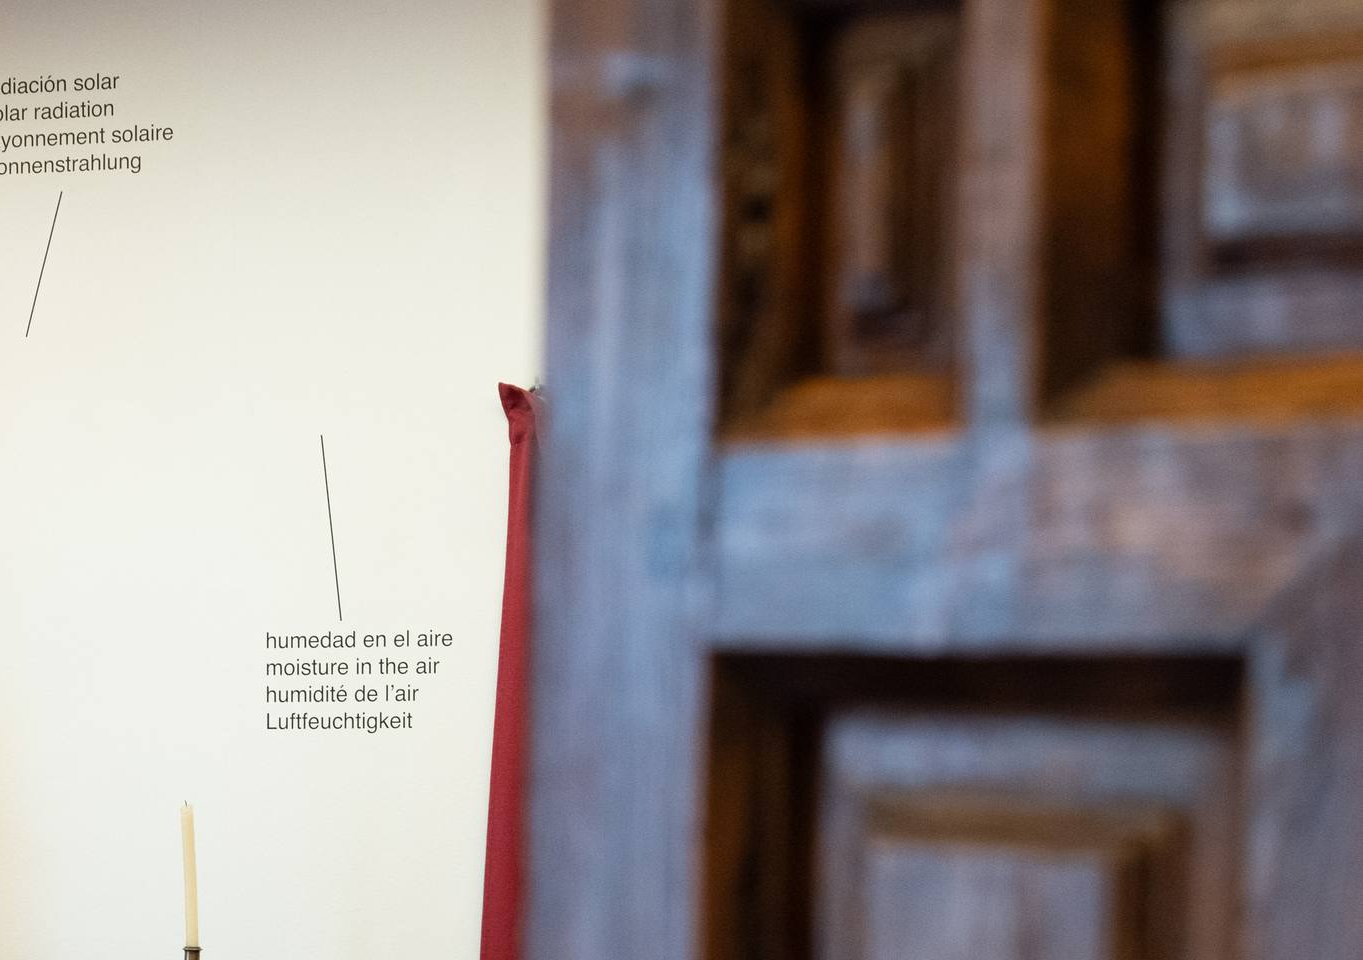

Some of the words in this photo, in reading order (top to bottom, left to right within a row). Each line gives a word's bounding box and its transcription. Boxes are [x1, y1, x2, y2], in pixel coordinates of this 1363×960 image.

[73, 73, 119, 90] solar
[34, 100, 114, 119] radiation
[111, 124, 173, 142] solaire
[266, 631, 355, 648] humedad
[362, 635, 386, 648] en
[393, 630, 409, 646] el
[416, 630, 452, 646] aire
[266, 659, 348, 675] moisture
[356, 658, 371, 674] in
[378, 657, 408, 673] the
[415, 657, 440, 673] air
[266, 685, 347, 702] humidité
[354, 685, 378, 701] de
[266, 712, 412, 733] Luftfeuchtigkeit
